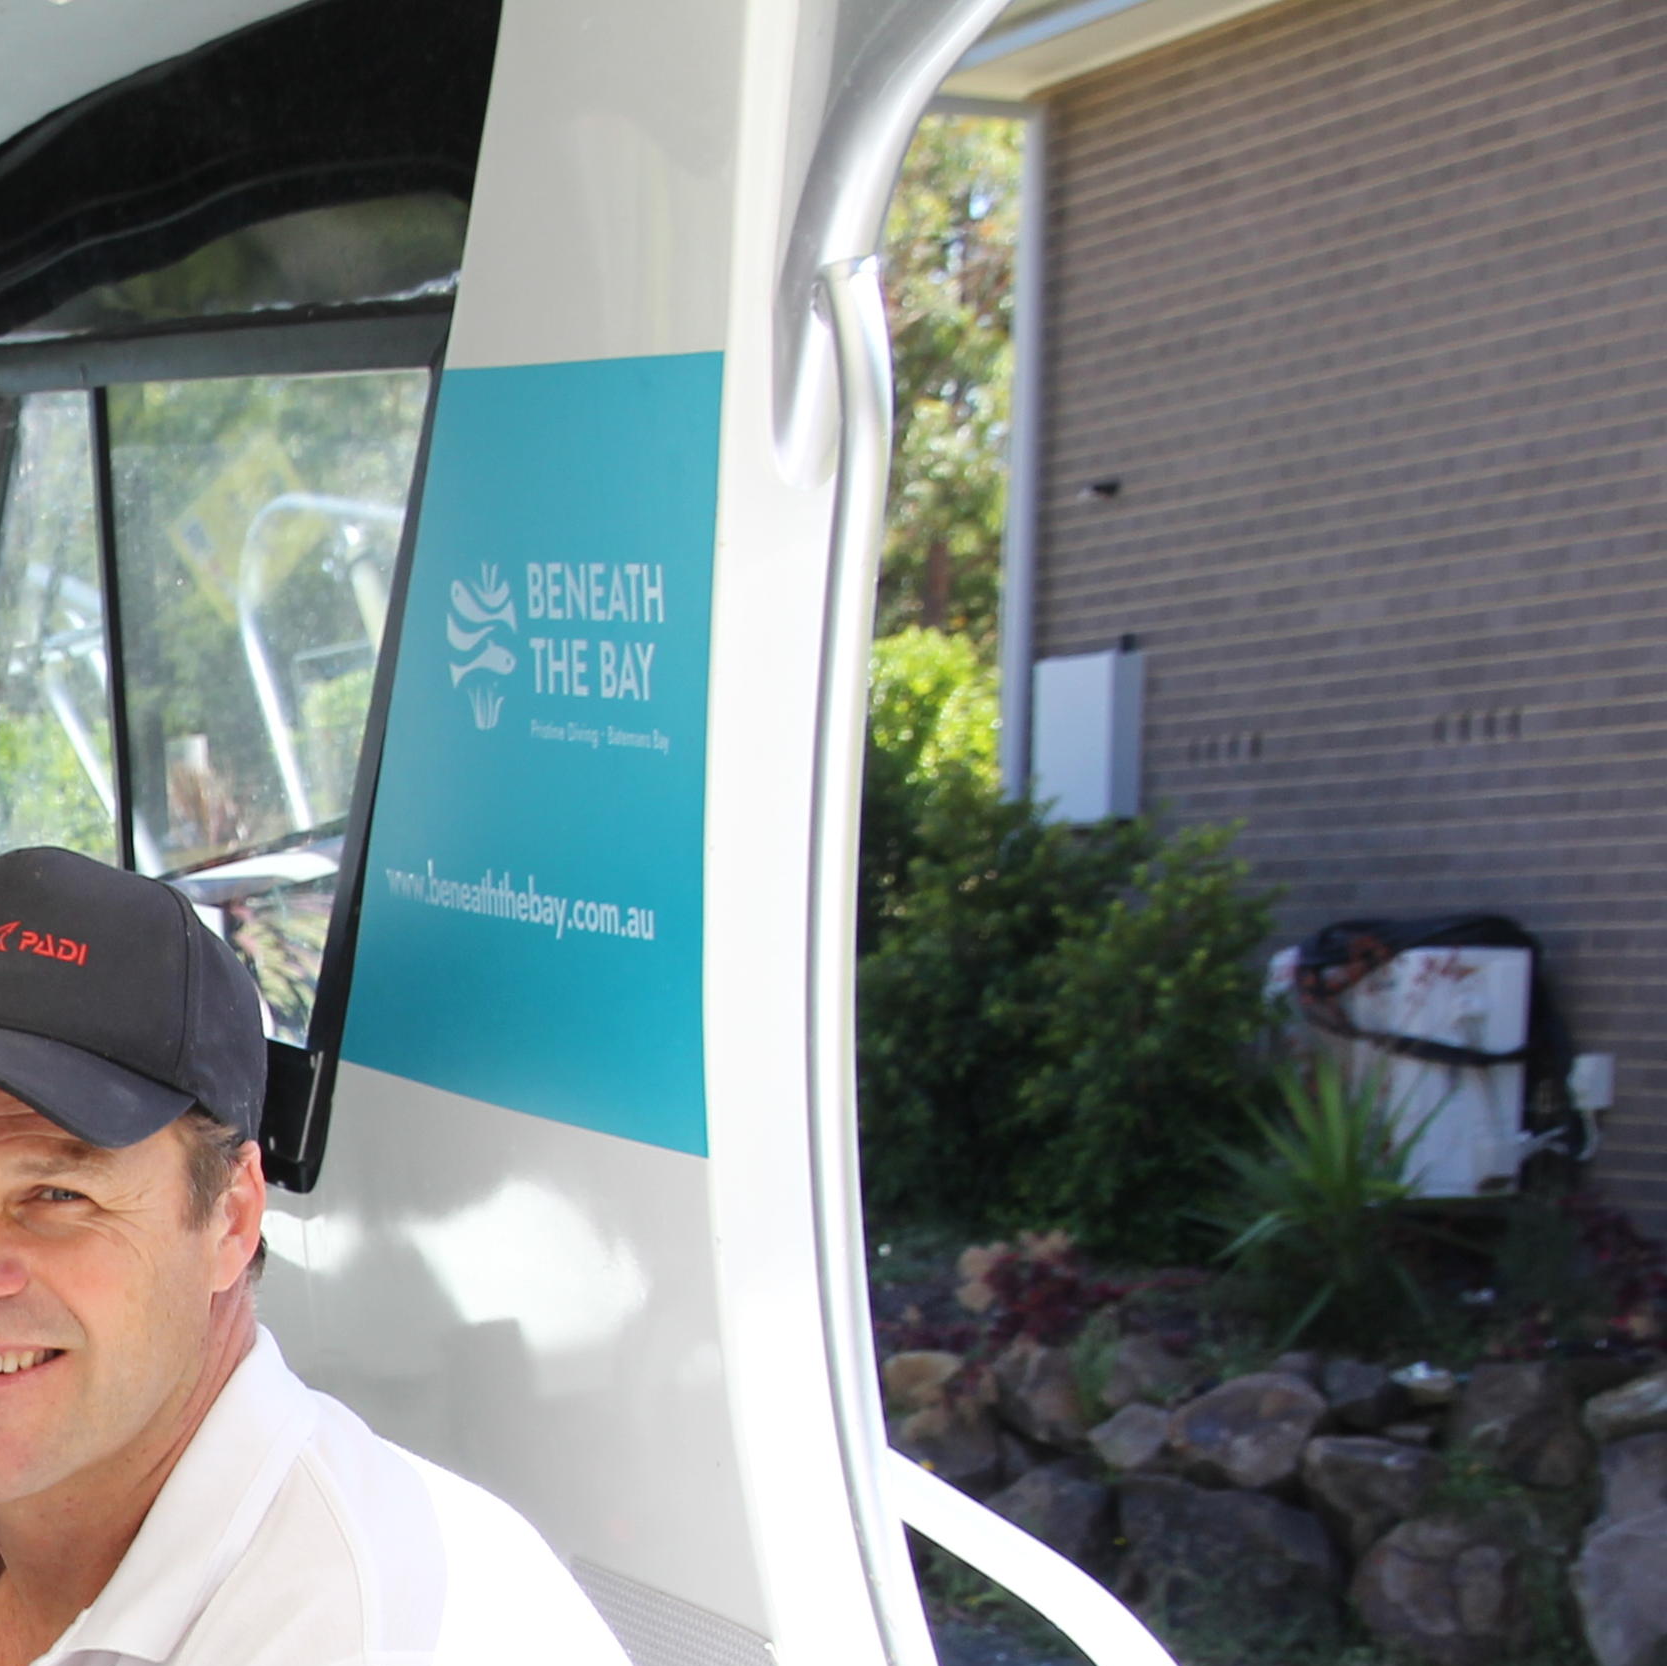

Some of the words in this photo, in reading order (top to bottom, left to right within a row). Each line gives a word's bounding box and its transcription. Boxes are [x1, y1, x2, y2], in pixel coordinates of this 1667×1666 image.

[526, 561, 665, 624] BENEATH
[528, 637, 589, 697] THE
[599, 639, 656, 701] BAY
[384, 858, 656, 941] www.beneaththebay.com.au
[18, 929, 89, 966] PADI
